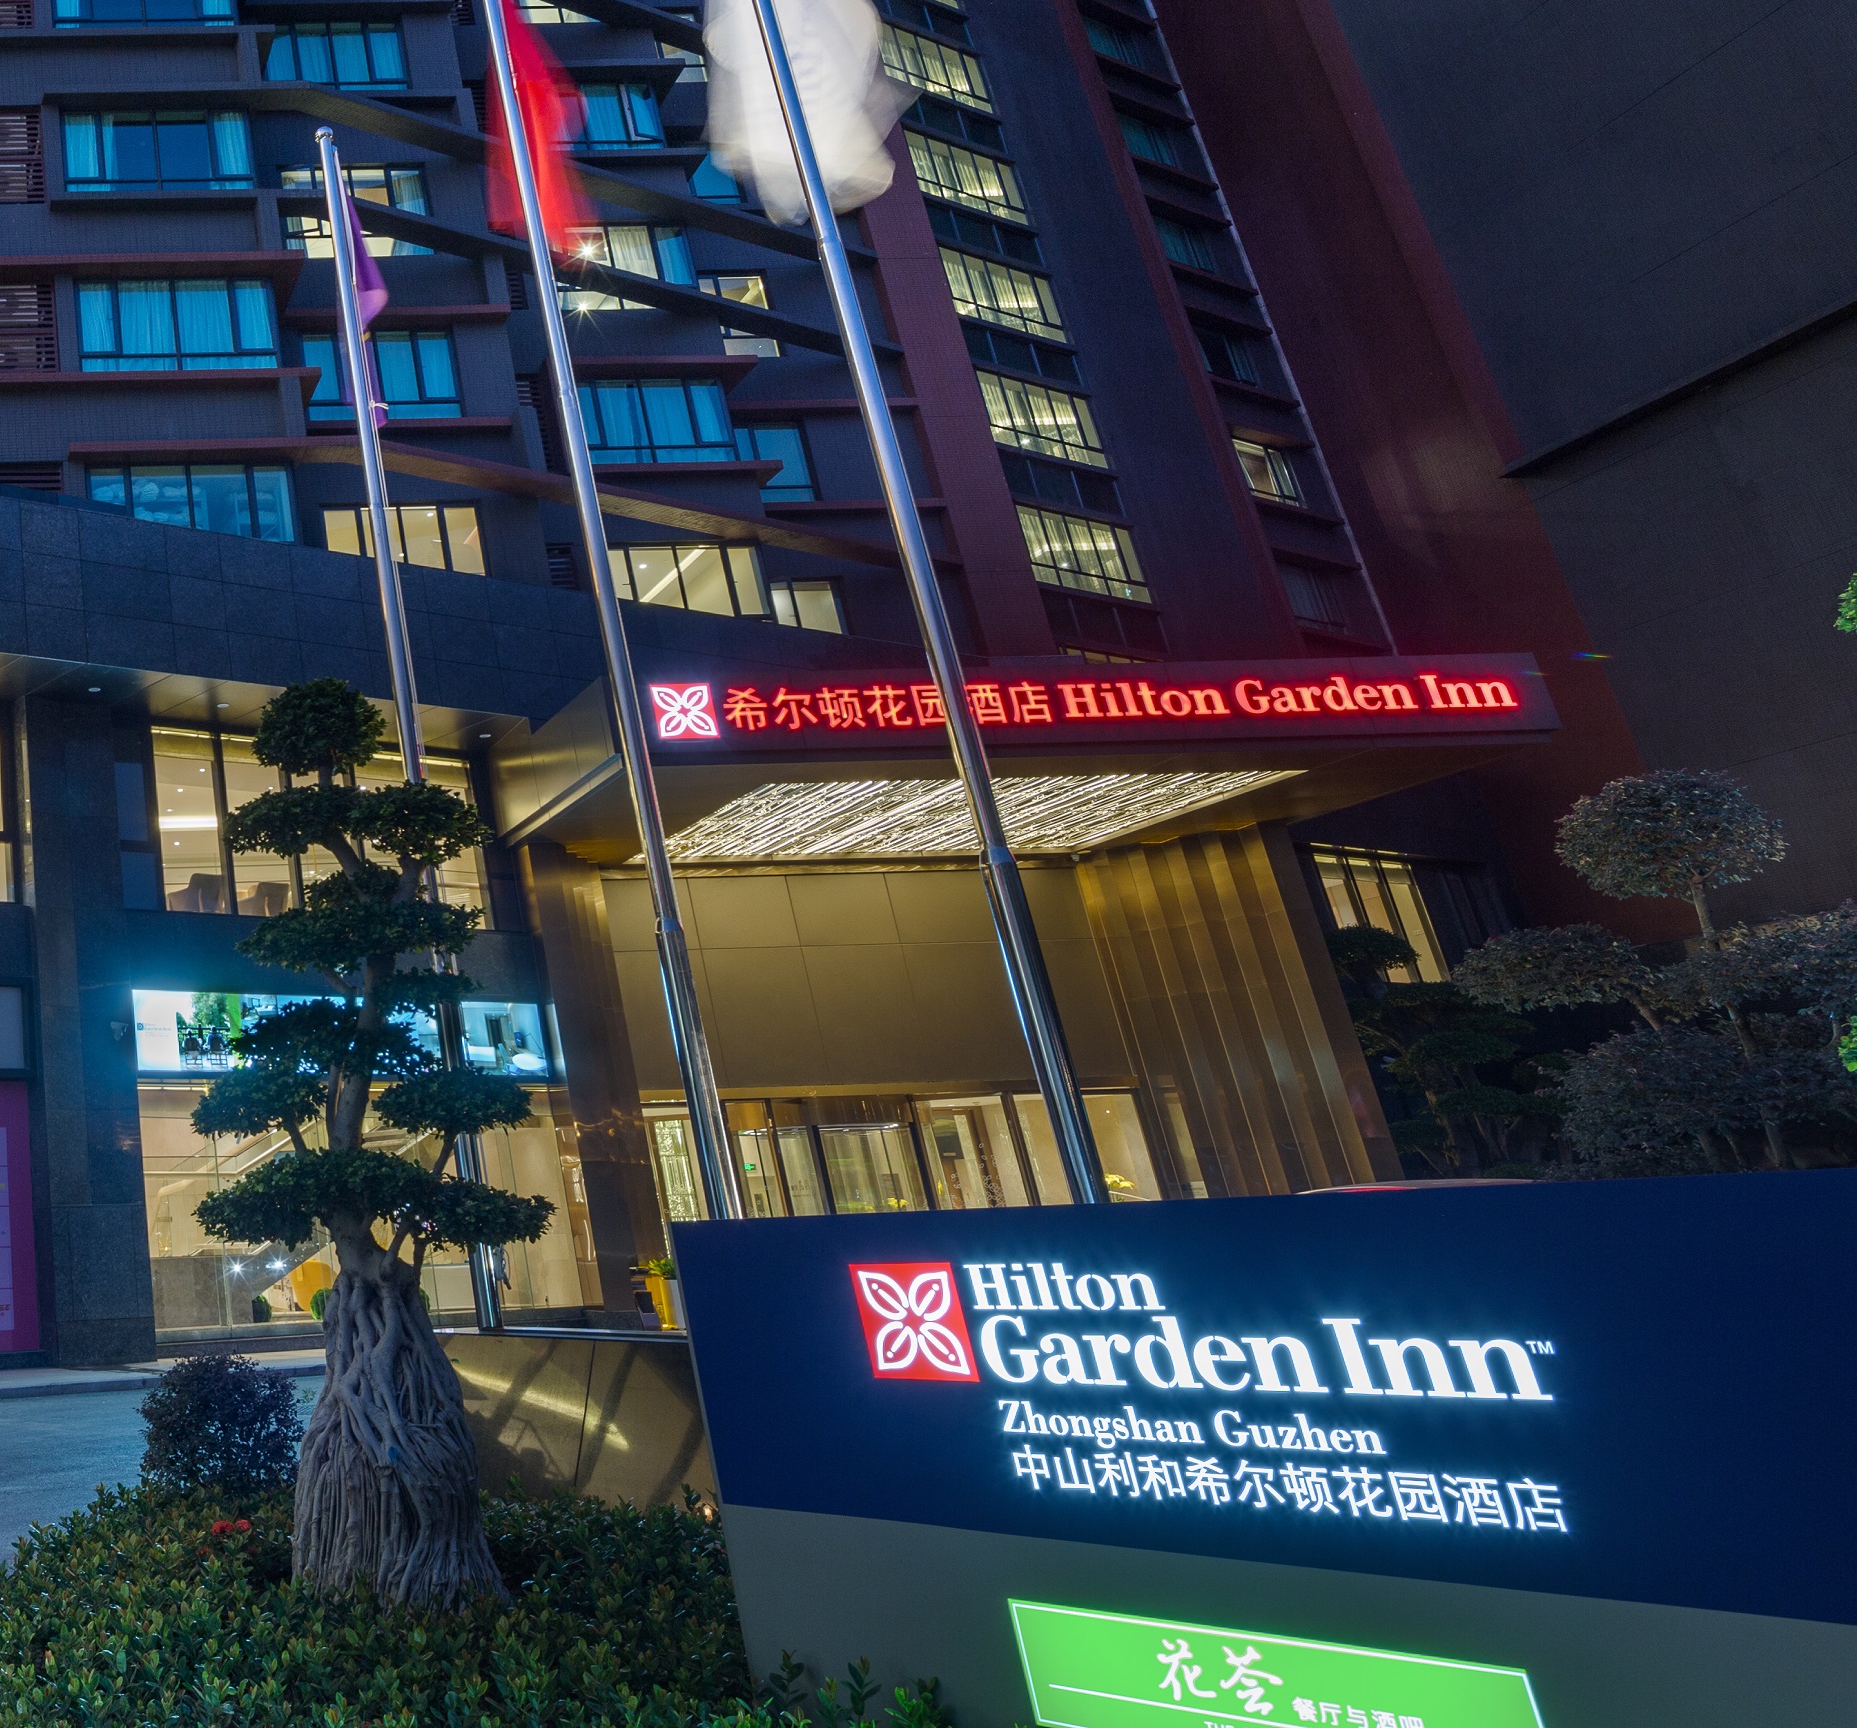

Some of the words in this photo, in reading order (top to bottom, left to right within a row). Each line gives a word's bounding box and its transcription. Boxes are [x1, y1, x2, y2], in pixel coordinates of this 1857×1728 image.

[722, 681, 1053, 730] 希尔顿花园酒店
[1057, 682, 1231, 718] Hilton
[1236, 676, 1414, 714] Garden
[1417, 674, 1519, 709] Inn
[963, 1262, 1165, 1311] Hilton
[980, 1315, 1329, 1394] Garden
[1321, 1318, 1553, 1401] Inn
[998, 1400, 1205, 1450] Zhongshan
[1213, 1410, 1387, 1456] Guzhen
[1012, 1444, 1569, 1534] 中山利和希尔顿花园酒店
